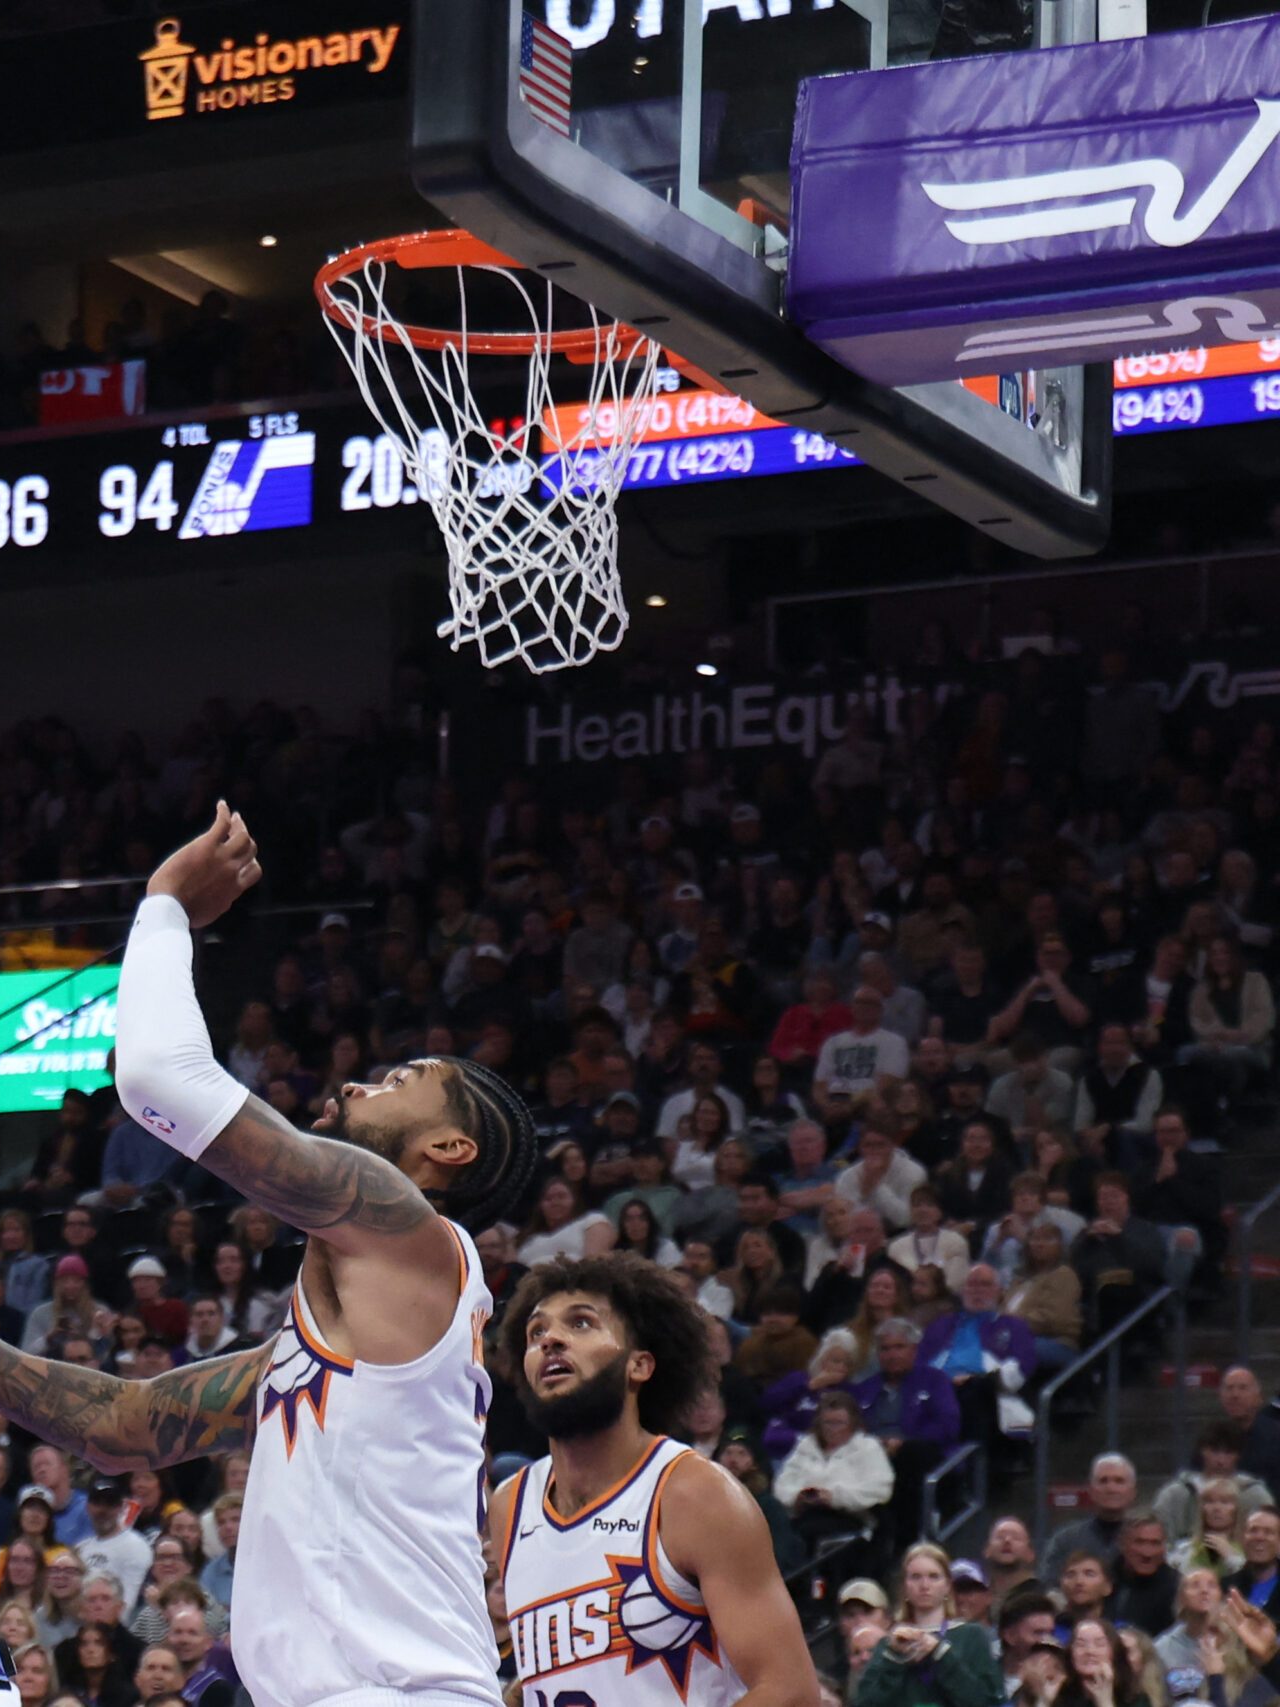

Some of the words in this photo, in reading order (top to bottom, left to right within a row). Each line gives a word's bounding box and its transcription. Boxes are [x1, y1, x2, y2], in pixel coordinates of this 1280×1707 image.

[193, 25, 400, 84] visionary
[196, 78, 295, 112] HOMES
[249, 416, 263, 438] 5
[264, 411, 299, 436] FLS
[578, 399, 673, 440] 2970
[676, 394, 756, 432] (41%)
[1113, 386, 1204, 432] (94%)
[162, 427, 177, 447] 4
[667, 437, 754, 481] (42%)
[98, 460, 178, 537] 94
[191, 451, 233, 532] BONUS
[524, 673, 961, 766] HealthEquit
[593, 1518, 641, 1535] PayPal
